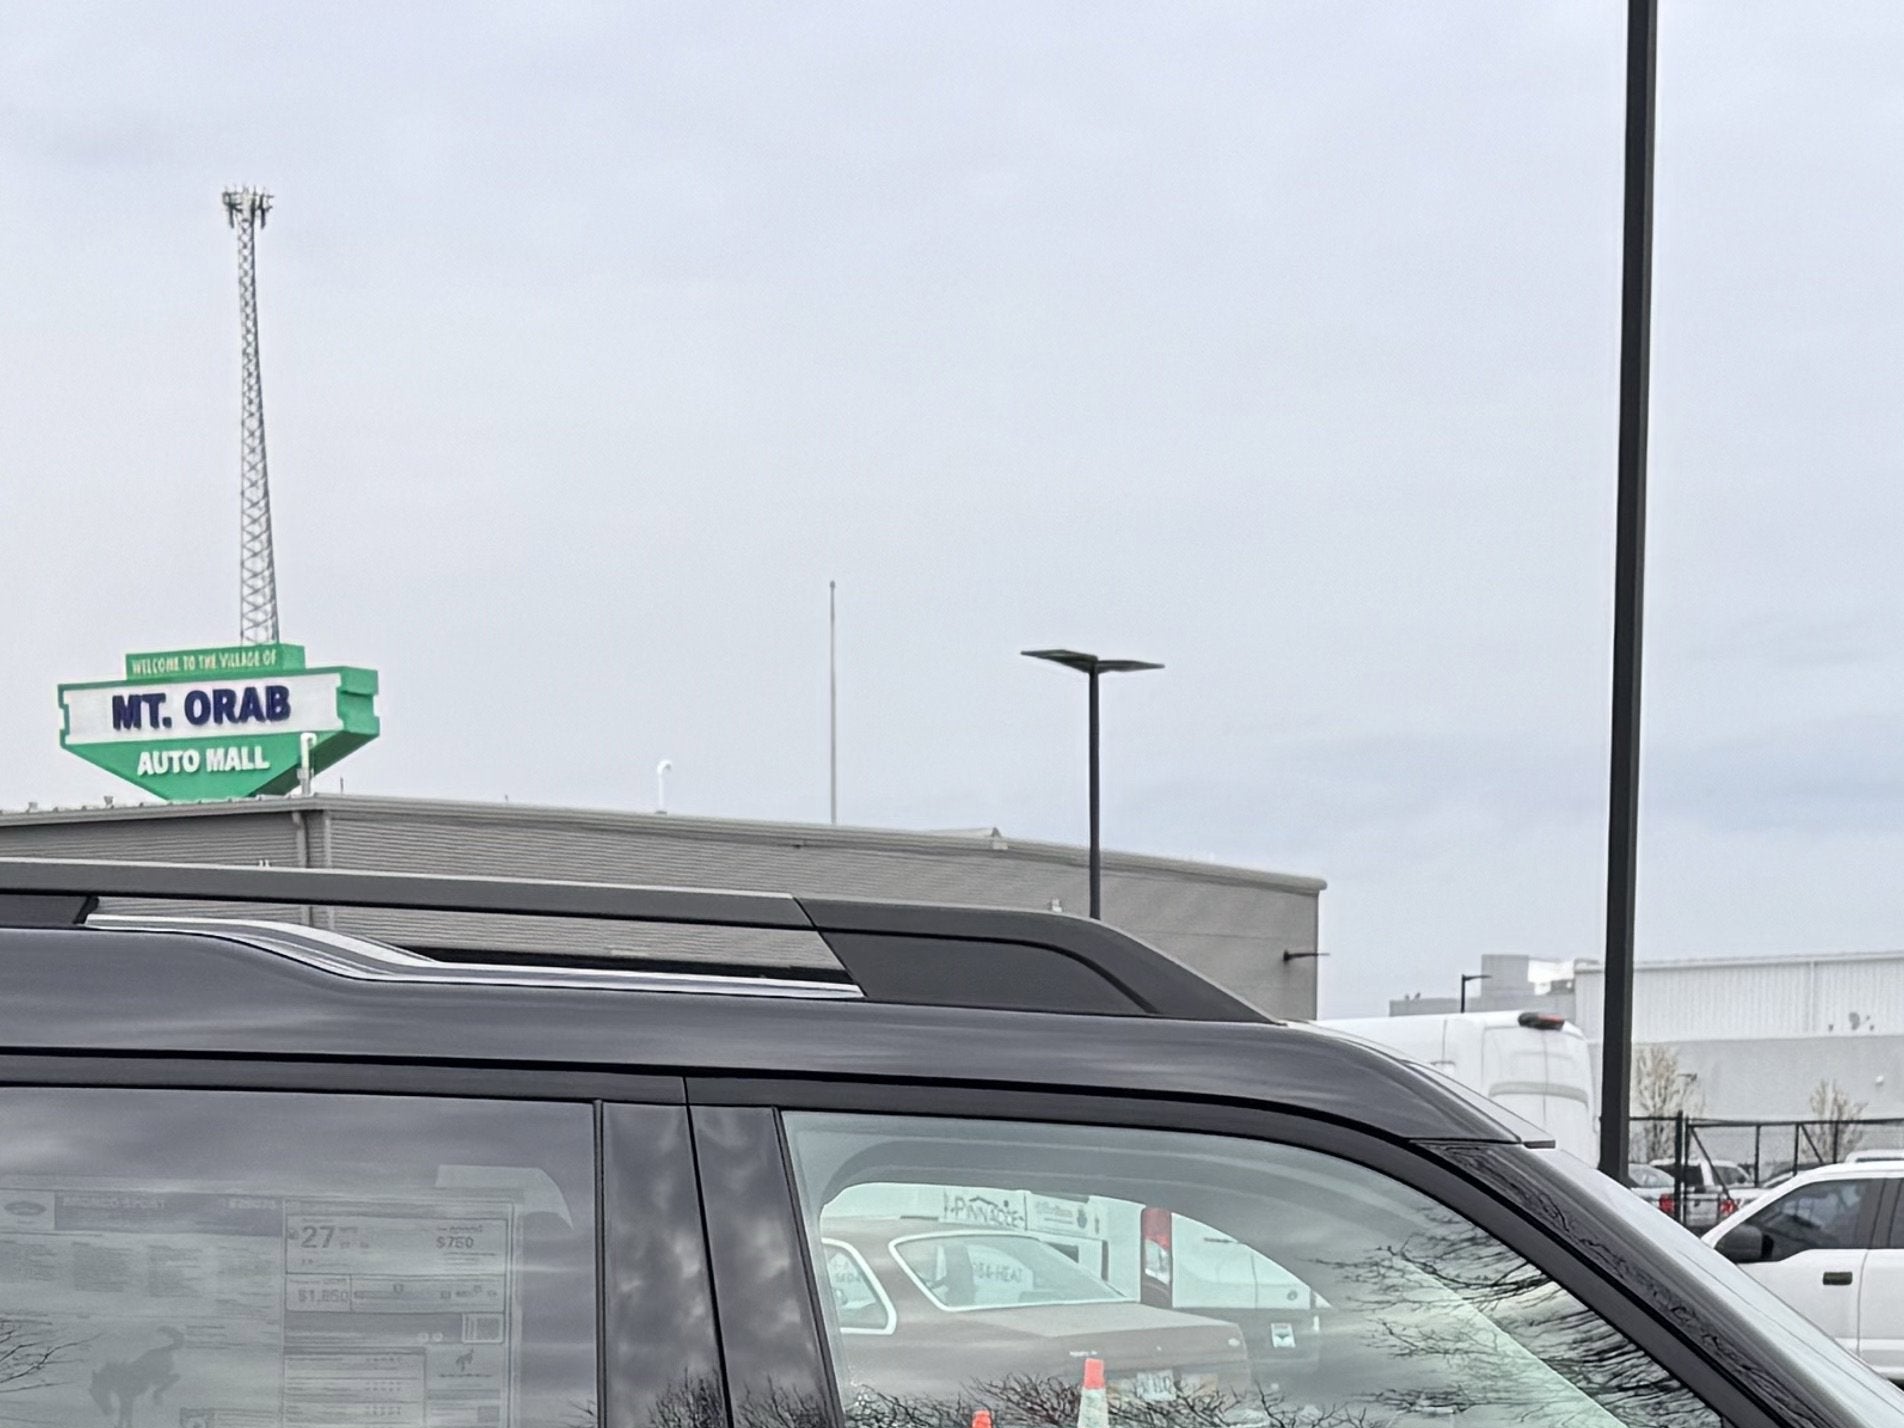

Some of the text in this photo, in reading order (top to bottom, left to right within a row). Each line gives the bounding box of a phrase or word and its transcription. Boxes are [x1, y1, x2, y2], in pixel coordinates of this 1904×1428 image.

[132, 649, 277, 675] WELCOME TO THE VILLAGE OF
[112, 684, 292, 731] MT. ORAB
[137, 744, 271, 777] AUTO MALL
[300, 1225, 336, 1249] 27
